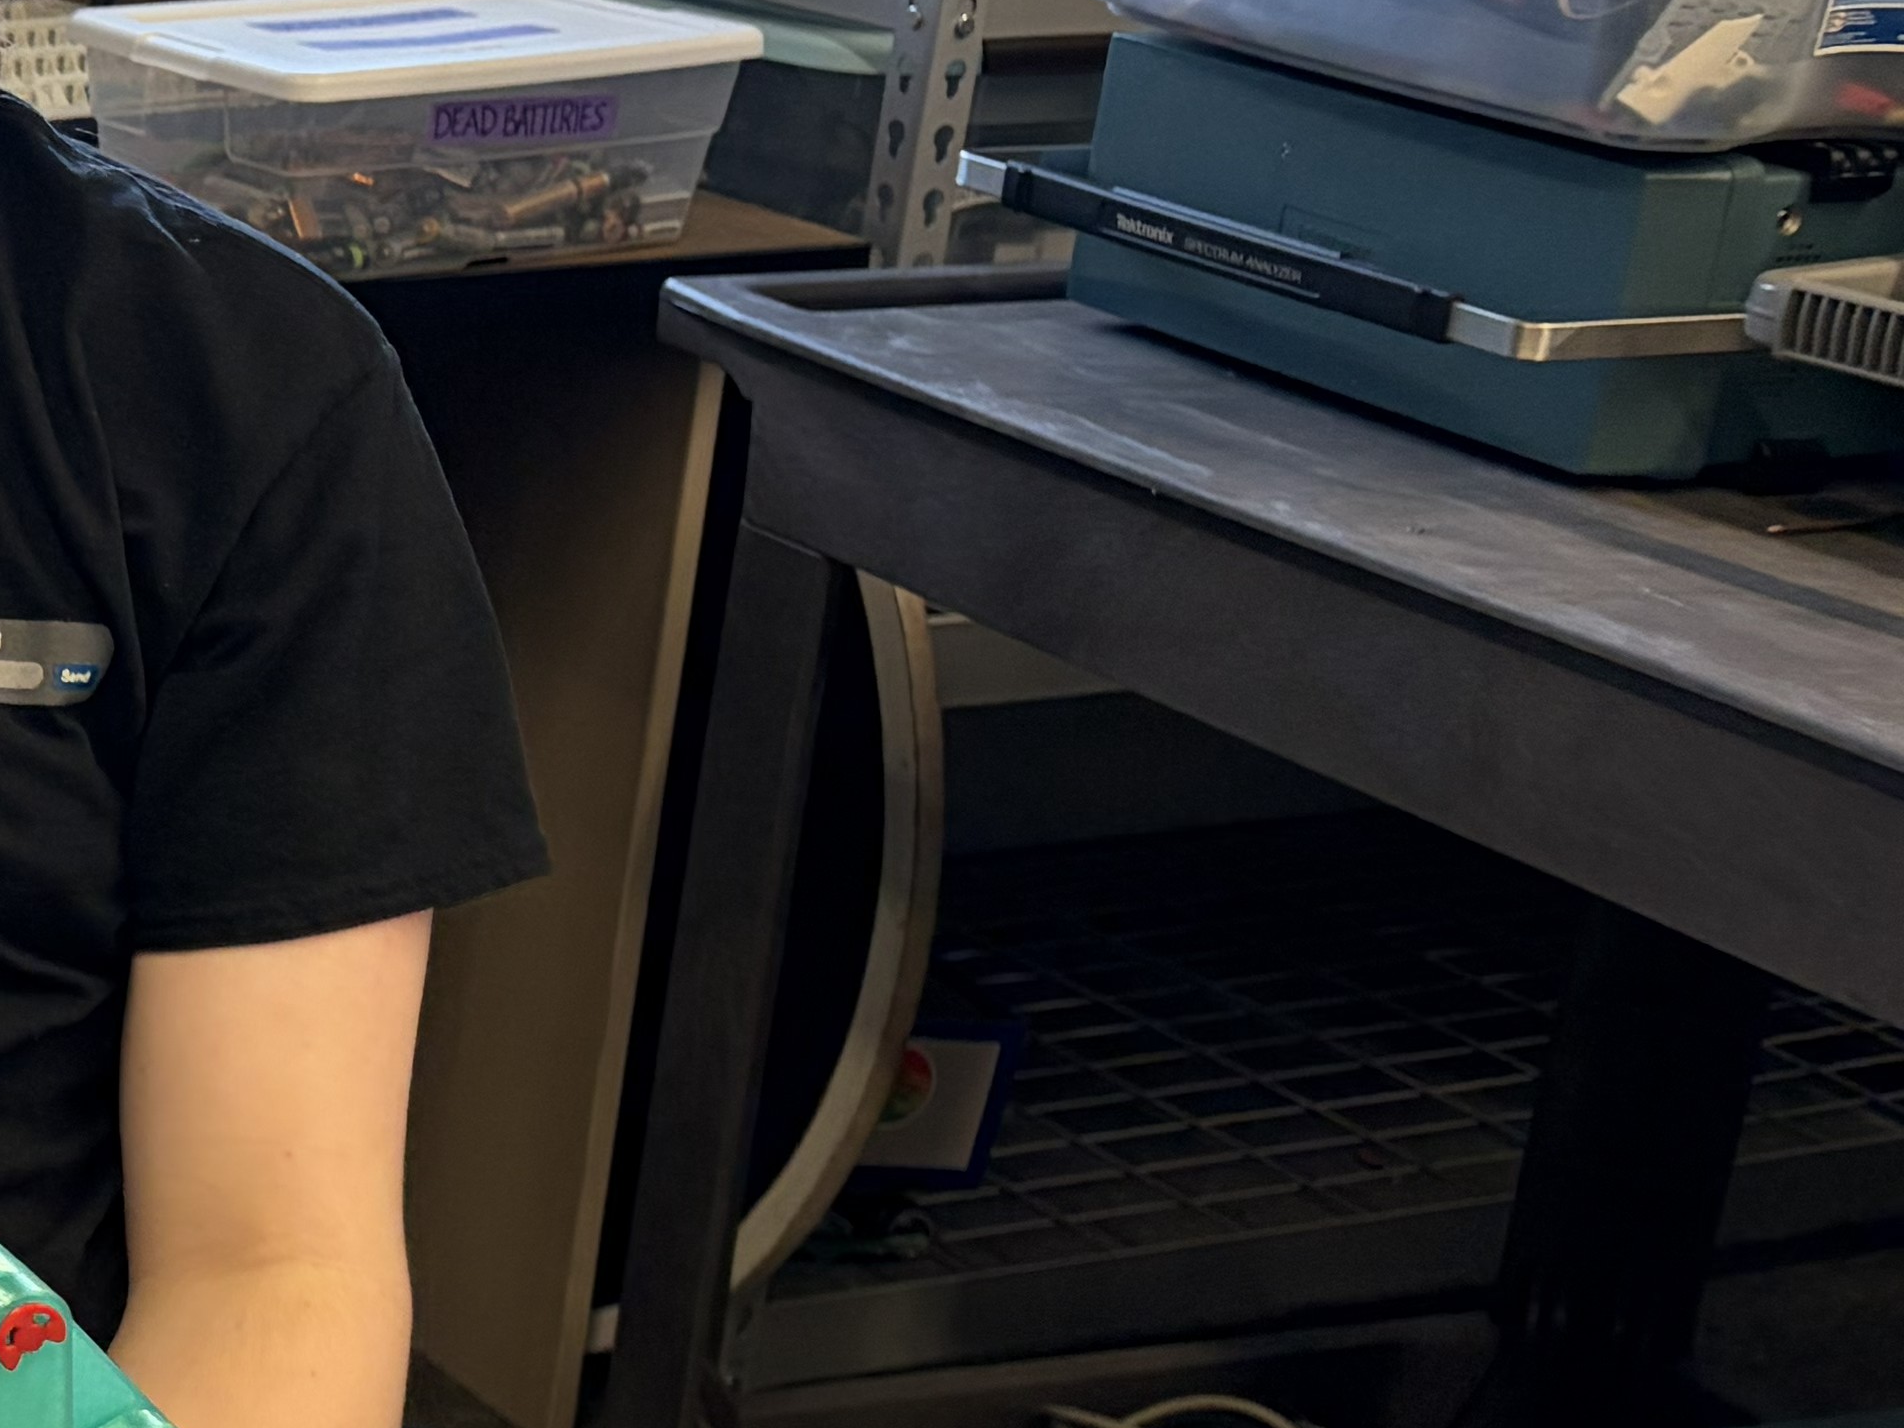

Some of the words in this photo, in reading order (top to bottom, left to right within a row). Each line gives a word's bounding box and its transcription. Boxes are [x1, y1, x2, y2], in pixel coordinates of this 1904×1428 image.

[433, 105, 498, 139] DEAD
[1116, 212, 1175, 245] Tektronix
[61, 668, 92, 684] Send
